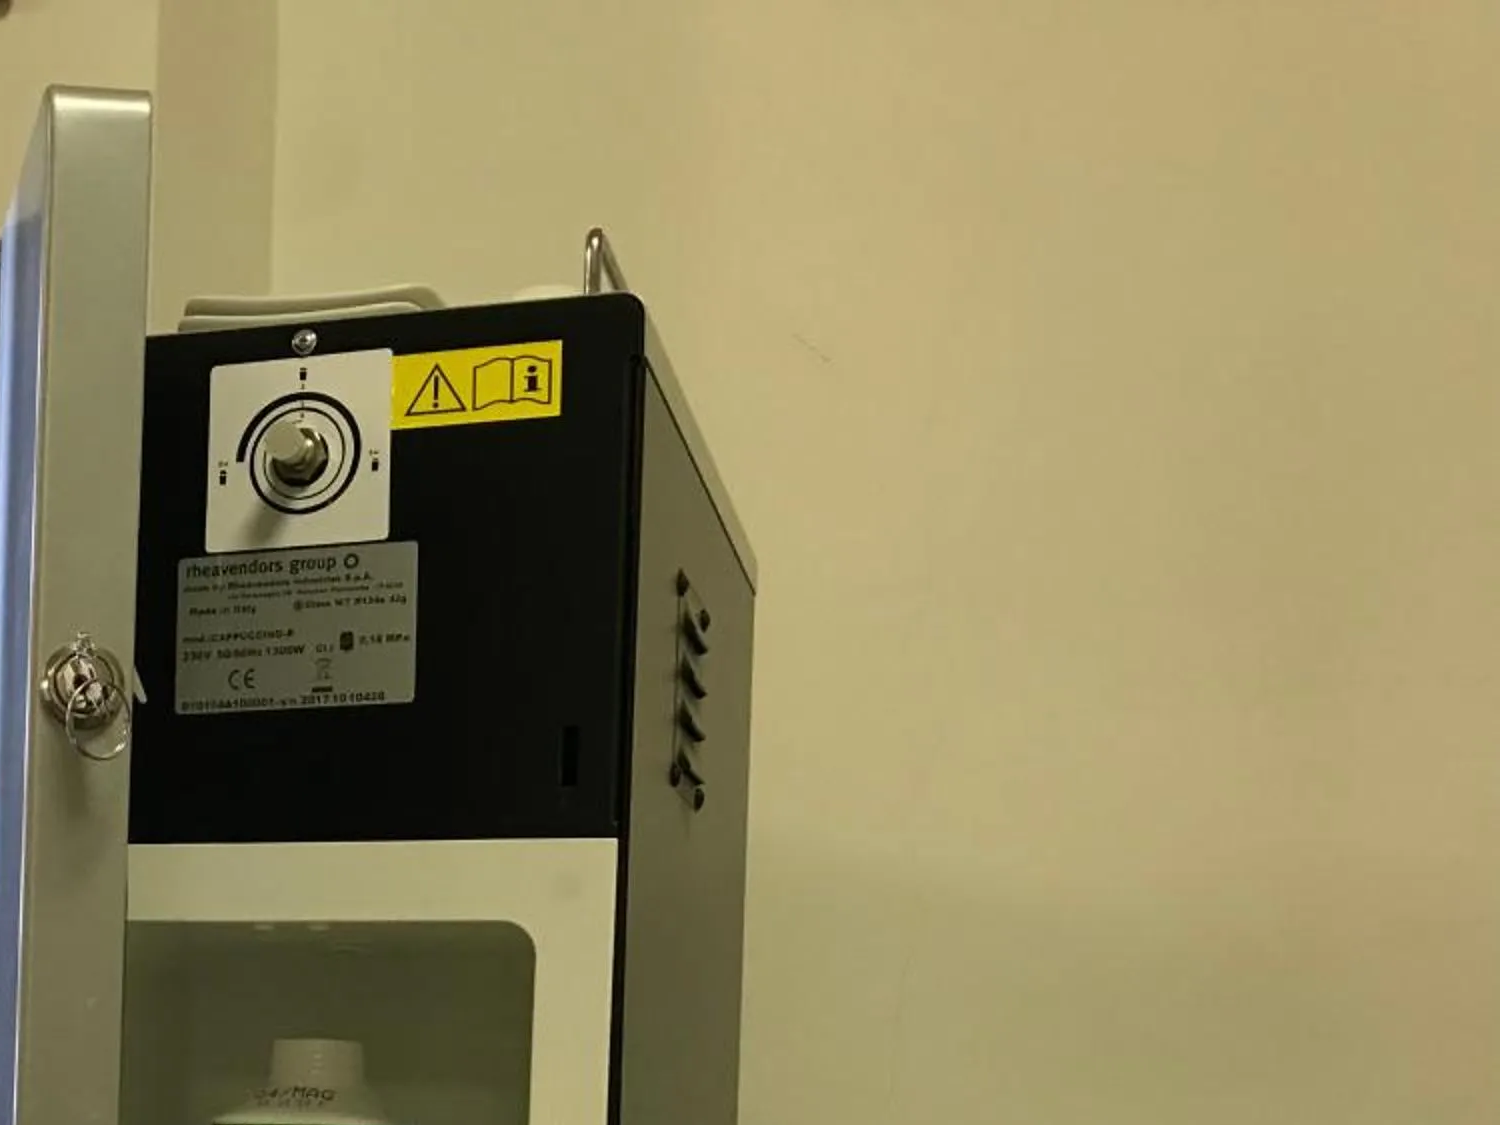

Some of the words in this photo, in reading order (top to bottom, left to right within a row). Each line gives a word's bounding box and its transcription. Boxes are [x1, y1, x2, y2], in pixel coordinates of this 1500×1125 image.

[186, 559, 283, 578] rheavendors
[289, 556, 337, 575] group
[227, 668, 256, 691] CE
